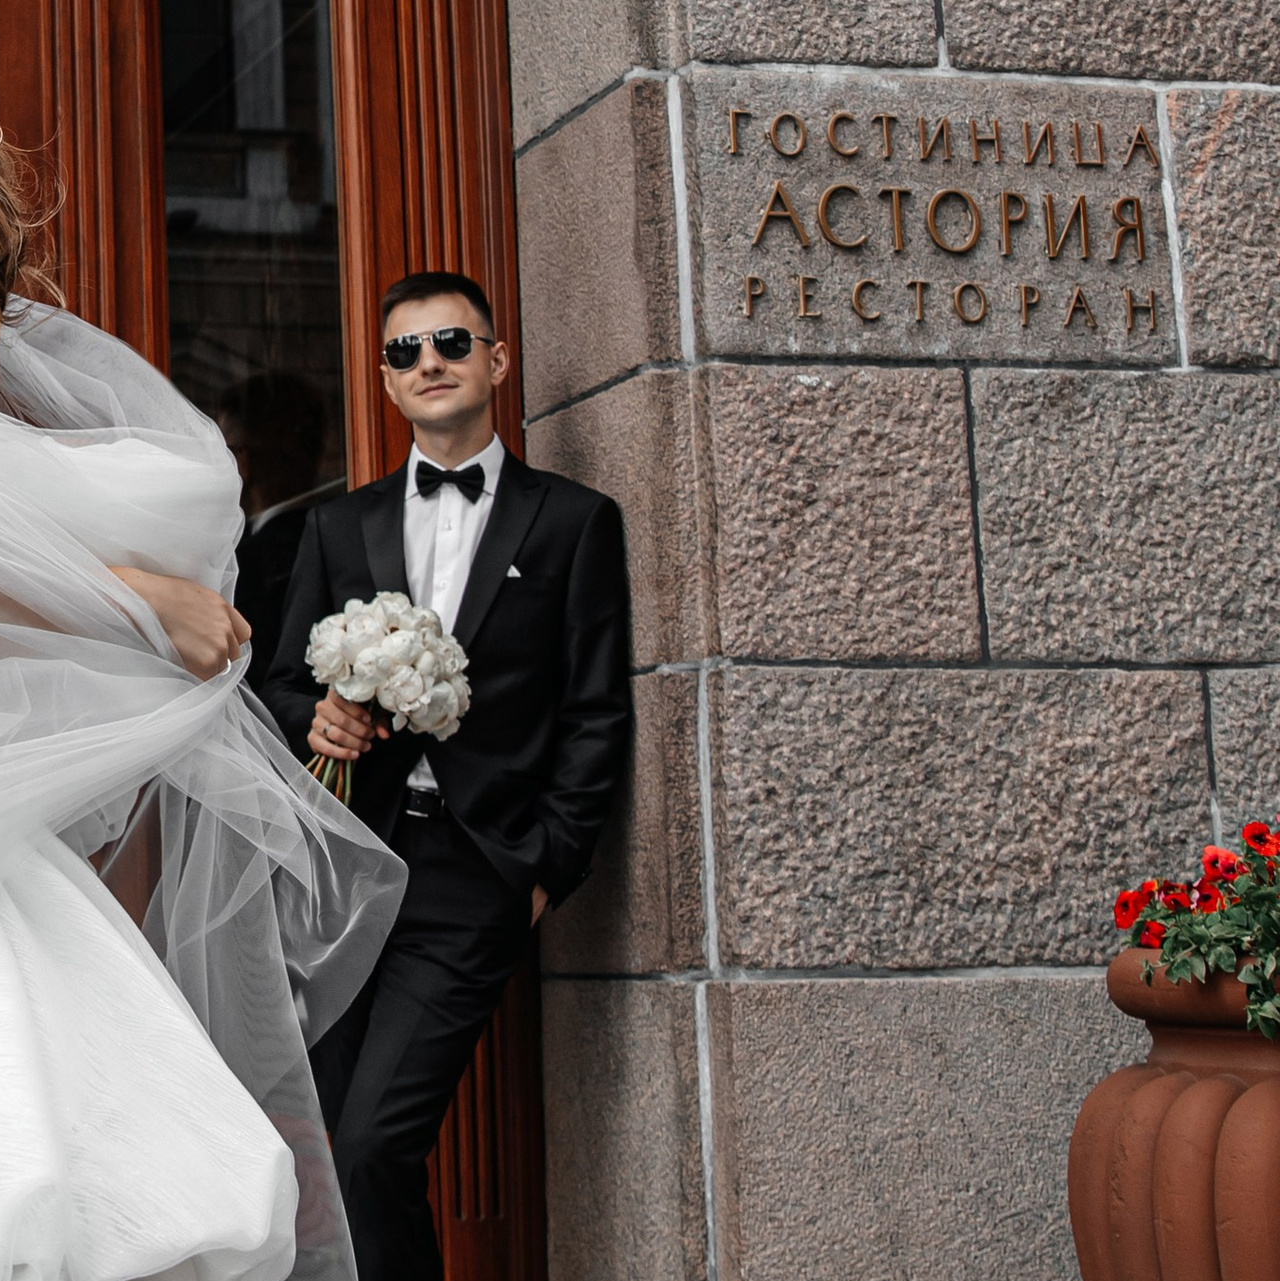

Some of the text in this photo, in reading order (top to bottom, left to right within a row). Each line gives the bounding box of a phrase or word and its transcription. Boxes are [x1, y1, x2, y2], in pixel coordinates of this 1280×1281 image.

[729, 109, 1161, 168] ГОСТИНИЦА
[752, 180, 1147, 262] АСТОРИЯ
[744, 275, 1156, 332] РЕСТОРАН
